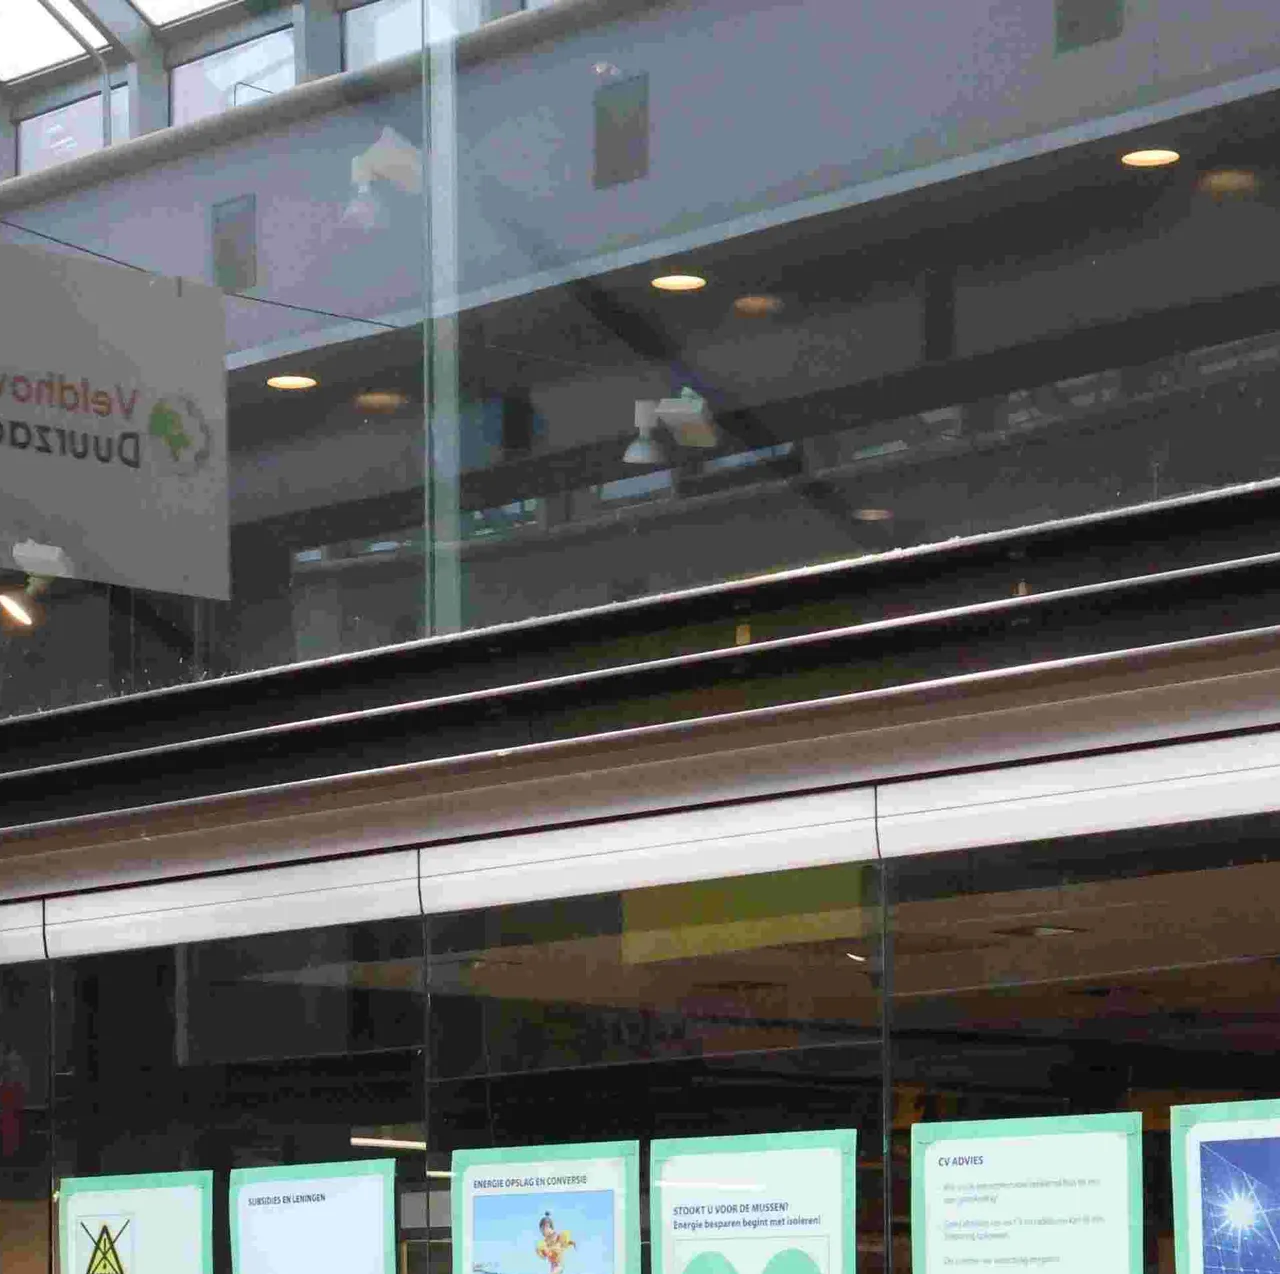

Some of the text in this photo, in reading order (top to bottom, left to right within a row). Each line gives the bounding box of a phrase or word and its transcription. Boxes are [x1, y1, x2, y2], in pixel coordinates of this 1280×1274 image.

[938, 1155, 984, 1167] CV ADVIES
[473, 1175, 587, 1189] ENERGIE OPSLAG EN CONVERSIE
[248, 1193, 326, 1206] SUBSIDIES EN LENINGEN
[673, 1202, 789, 1215] STOOKT U VOOR DE MUSSEN?
[673, 1220, 703, 1231] Energie
[704, 1219, 741, 1230] besparen
[742, 1218, 768, 1229] begint
[770, 1218, 785, 1226] met
